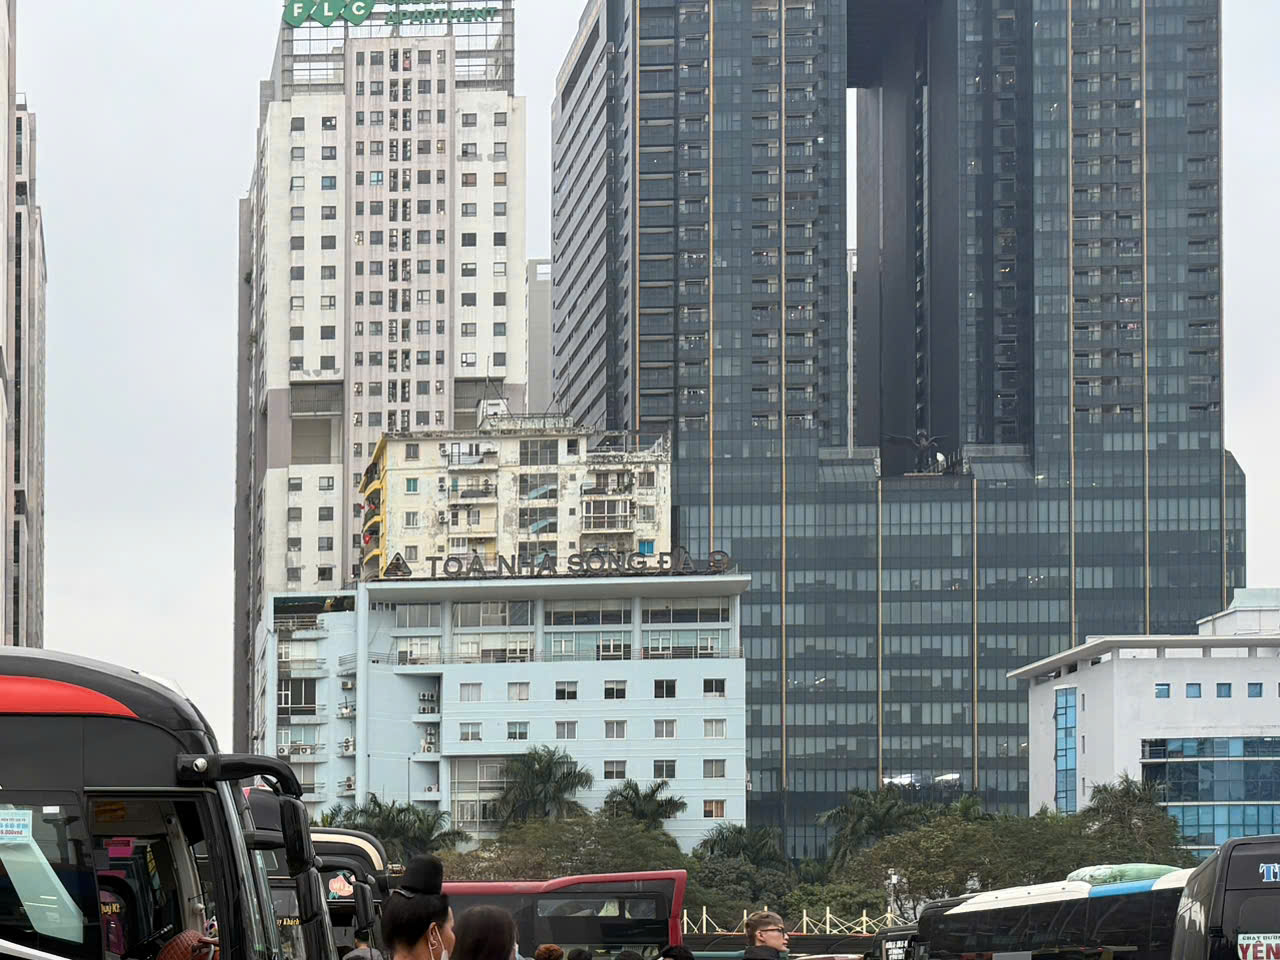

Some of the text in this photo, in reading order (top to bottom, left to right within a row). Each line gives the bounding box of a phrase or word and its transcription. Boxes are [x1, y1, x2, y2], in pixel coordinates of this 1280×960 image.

[385, 7, 497, 25] APARTMENT
[567, 547, 647, 575] SÔNG
[1238, 940, 1280, 960] YÊN
